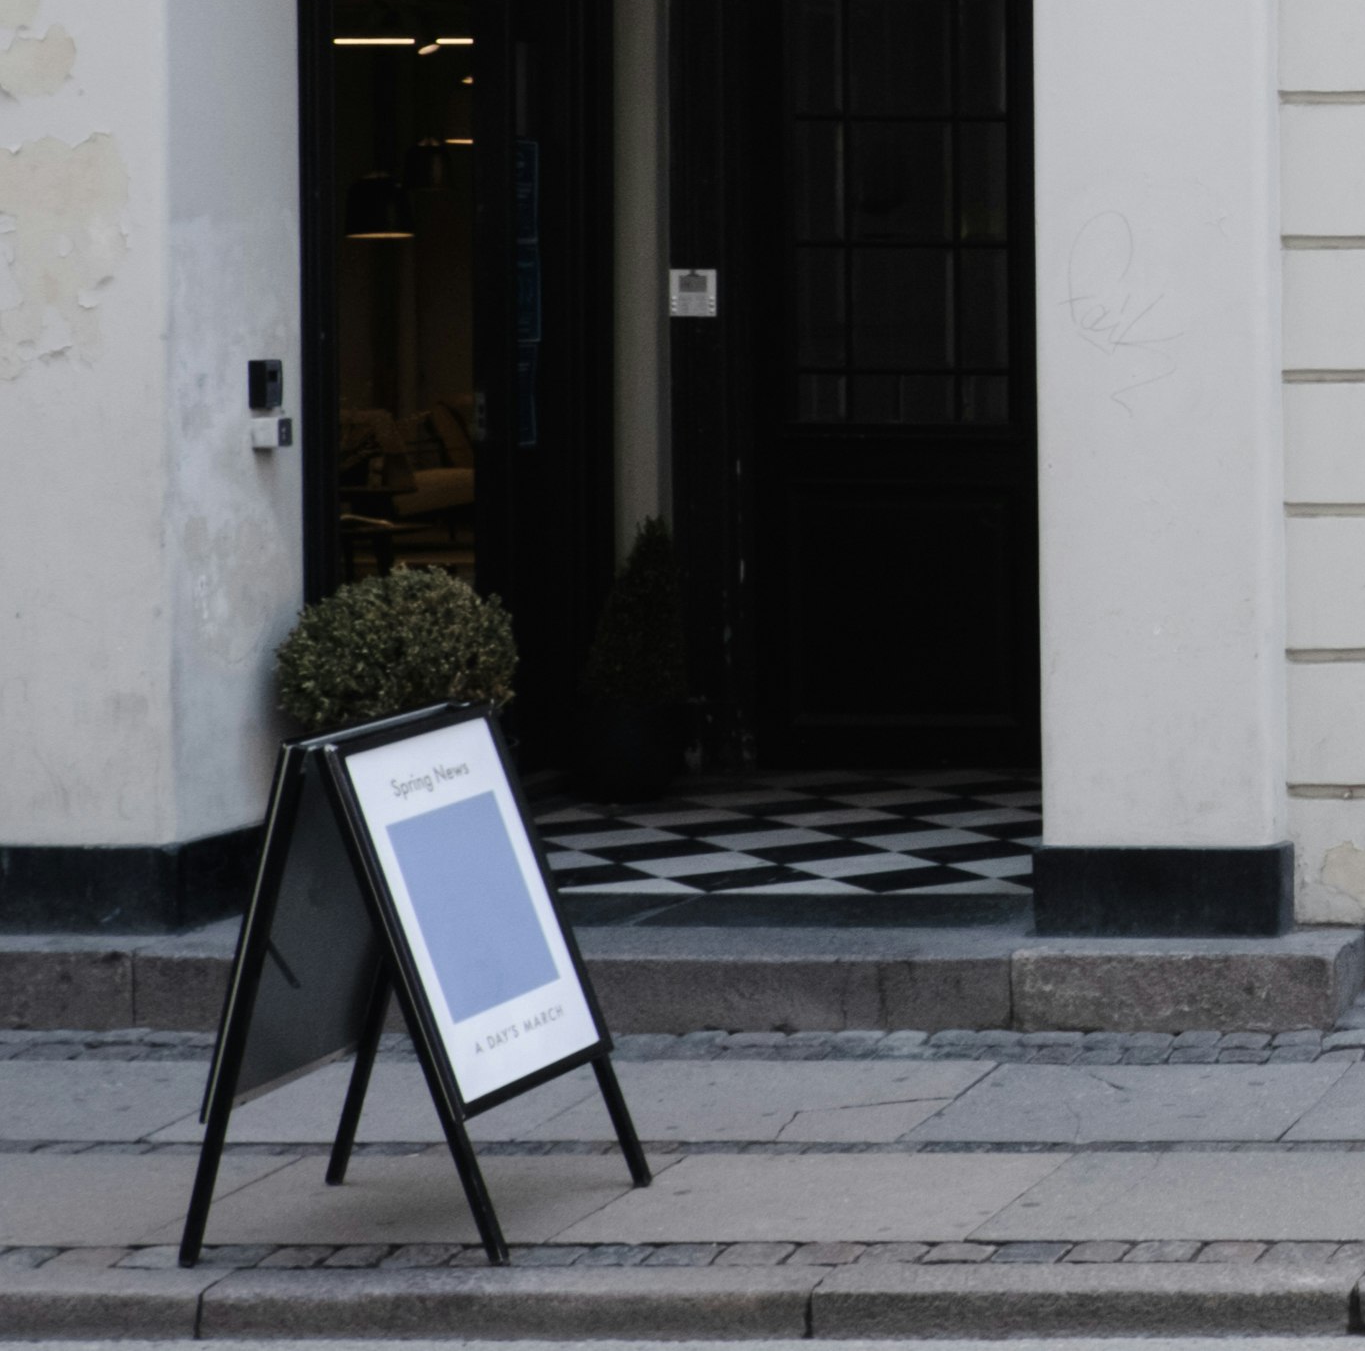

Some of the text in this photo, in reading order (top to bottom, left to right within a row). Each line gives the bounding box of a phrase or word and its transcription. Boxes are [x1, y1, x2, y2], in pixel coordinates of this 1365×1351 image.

[390, 762, 470, 800] Spring News
[475, 1041, 484, 1055] A
[523, 1004, 565, 1033] MARCH
